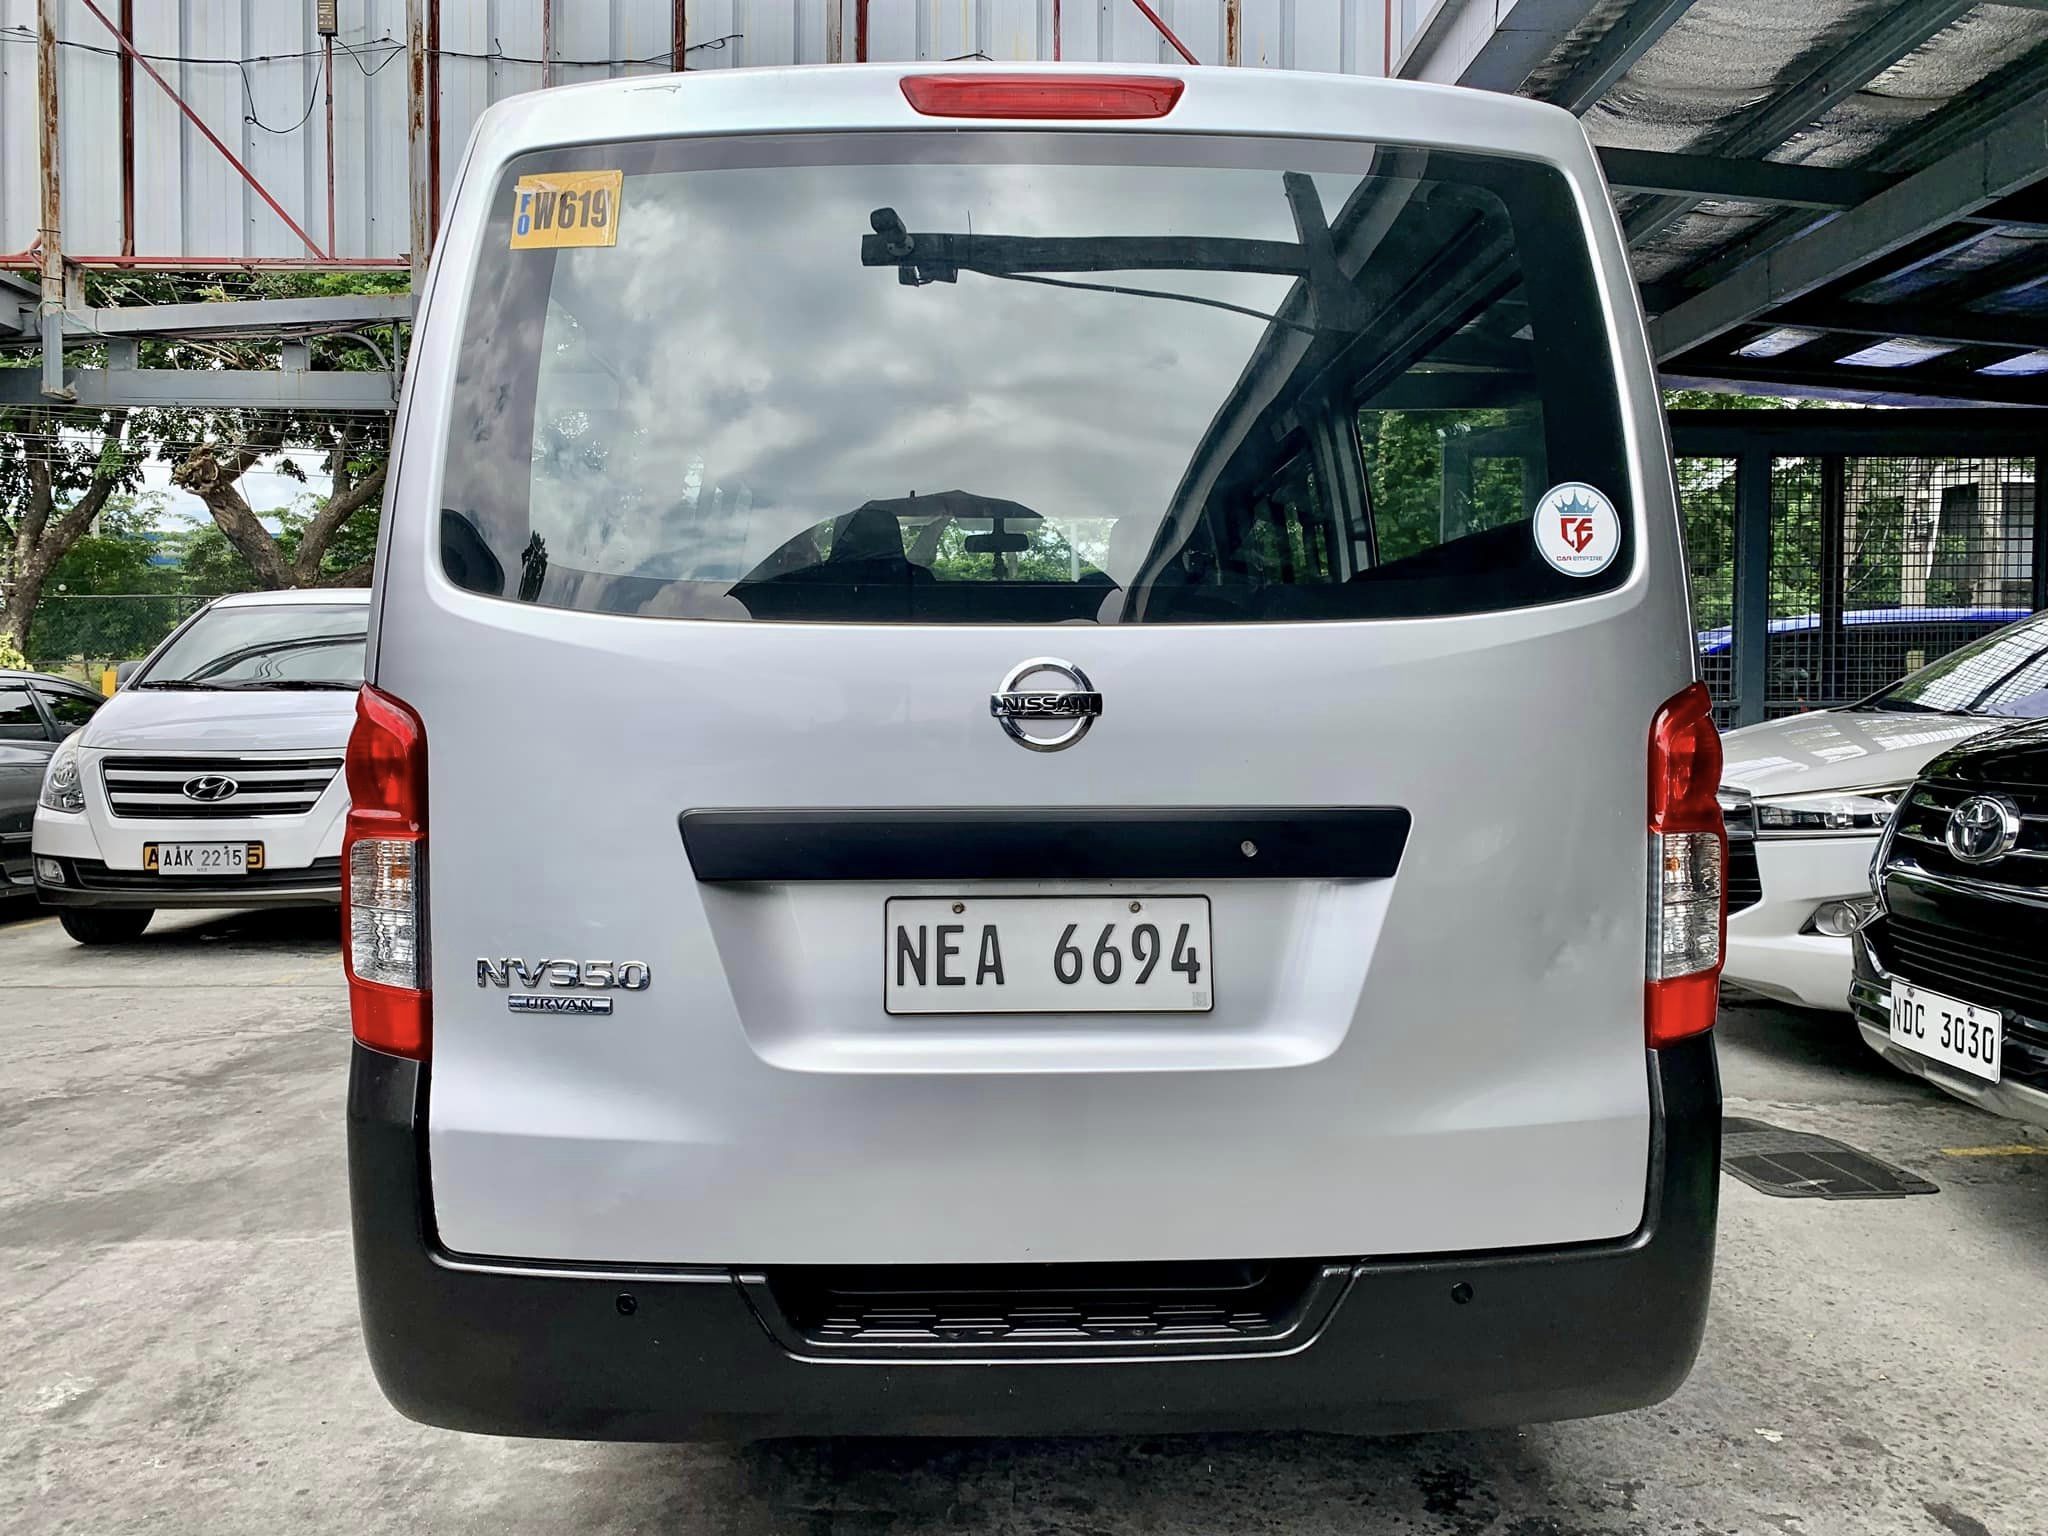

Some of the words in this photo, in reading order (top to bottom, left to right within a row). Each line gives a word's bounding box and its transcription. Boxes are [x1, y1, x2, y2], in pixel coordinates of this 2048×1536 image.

[1001, 693, 1091, 711] NISSAN
[164, 849, 193, 866] AAK
[201, 849, 241, 866] 2215
[897, 924, 1005, 986] NEA
[1053, 923, 1200, 985] 6694
[476, 957, 651, 991] NV350
[526, 998, 593, 1011] URVAN
[1893, 995, 1925, 1039] NDC
[1941, 1011, 1994, 1064] 3030
